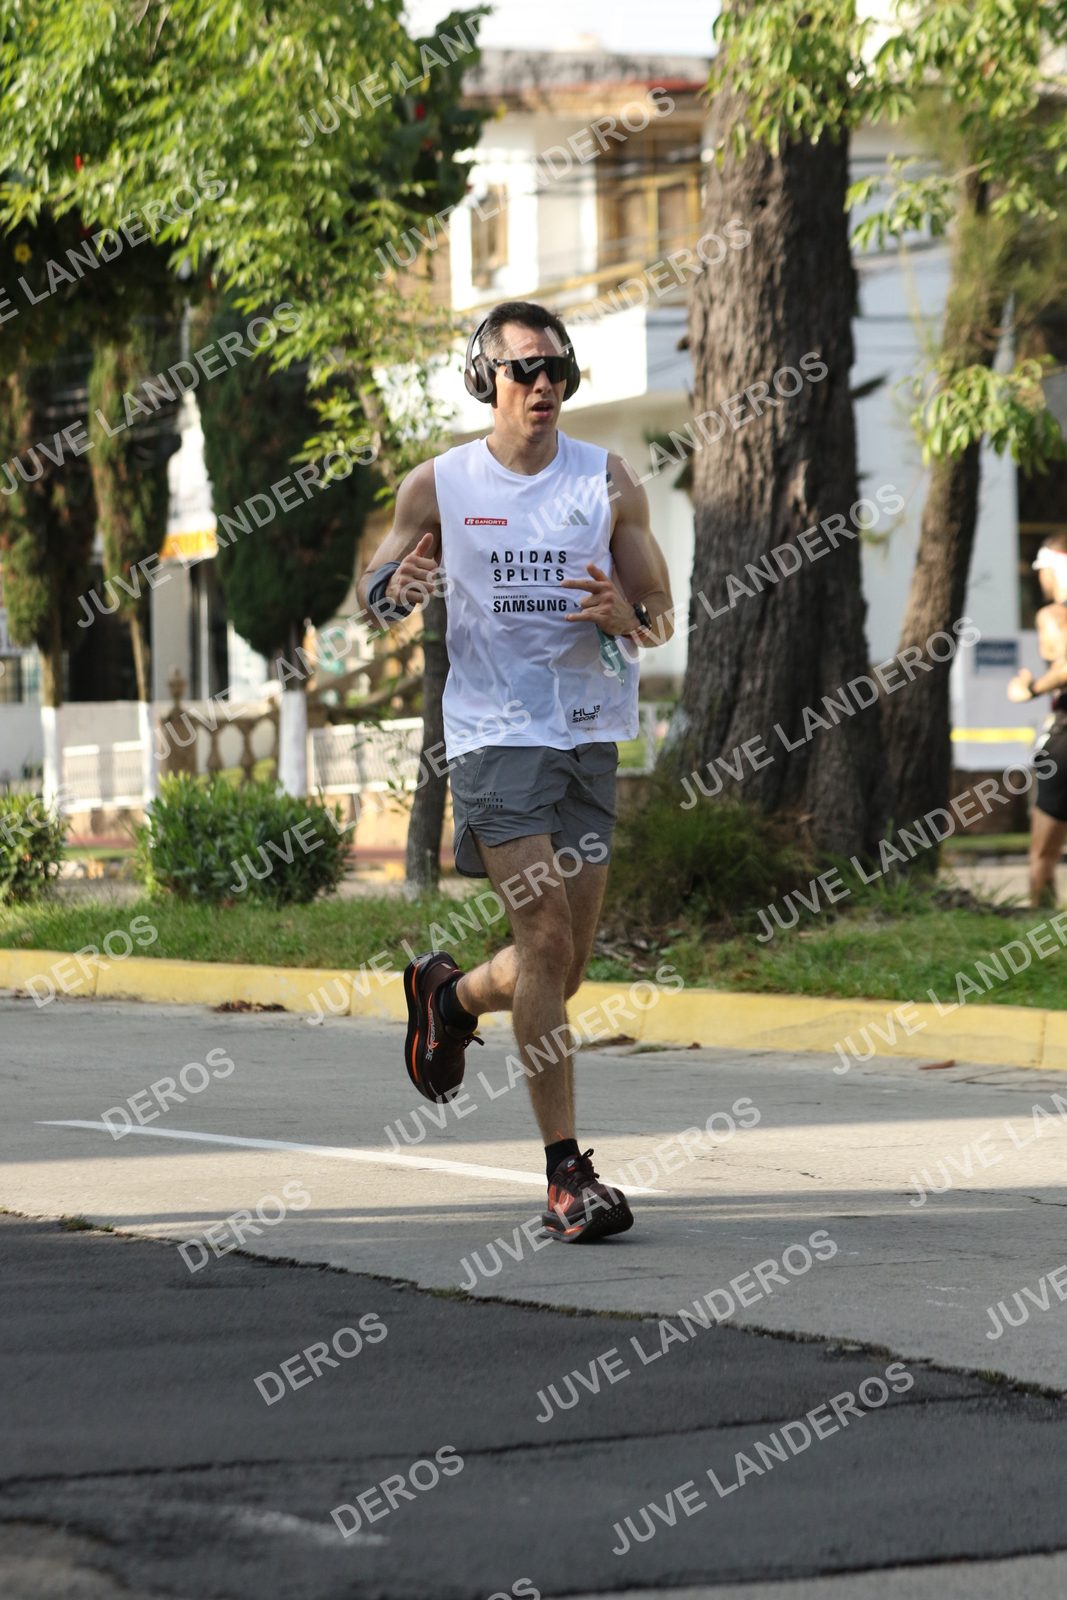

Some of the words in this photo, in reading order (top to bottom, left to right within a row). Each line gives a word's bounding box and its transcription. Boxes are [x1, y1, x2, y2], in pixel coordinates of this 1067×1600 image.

[491, 551, 567, 563] ADIDAS
[494, 568, 564, 581] SPLITS
[493, 599, 567, 613] SAMSUNG
